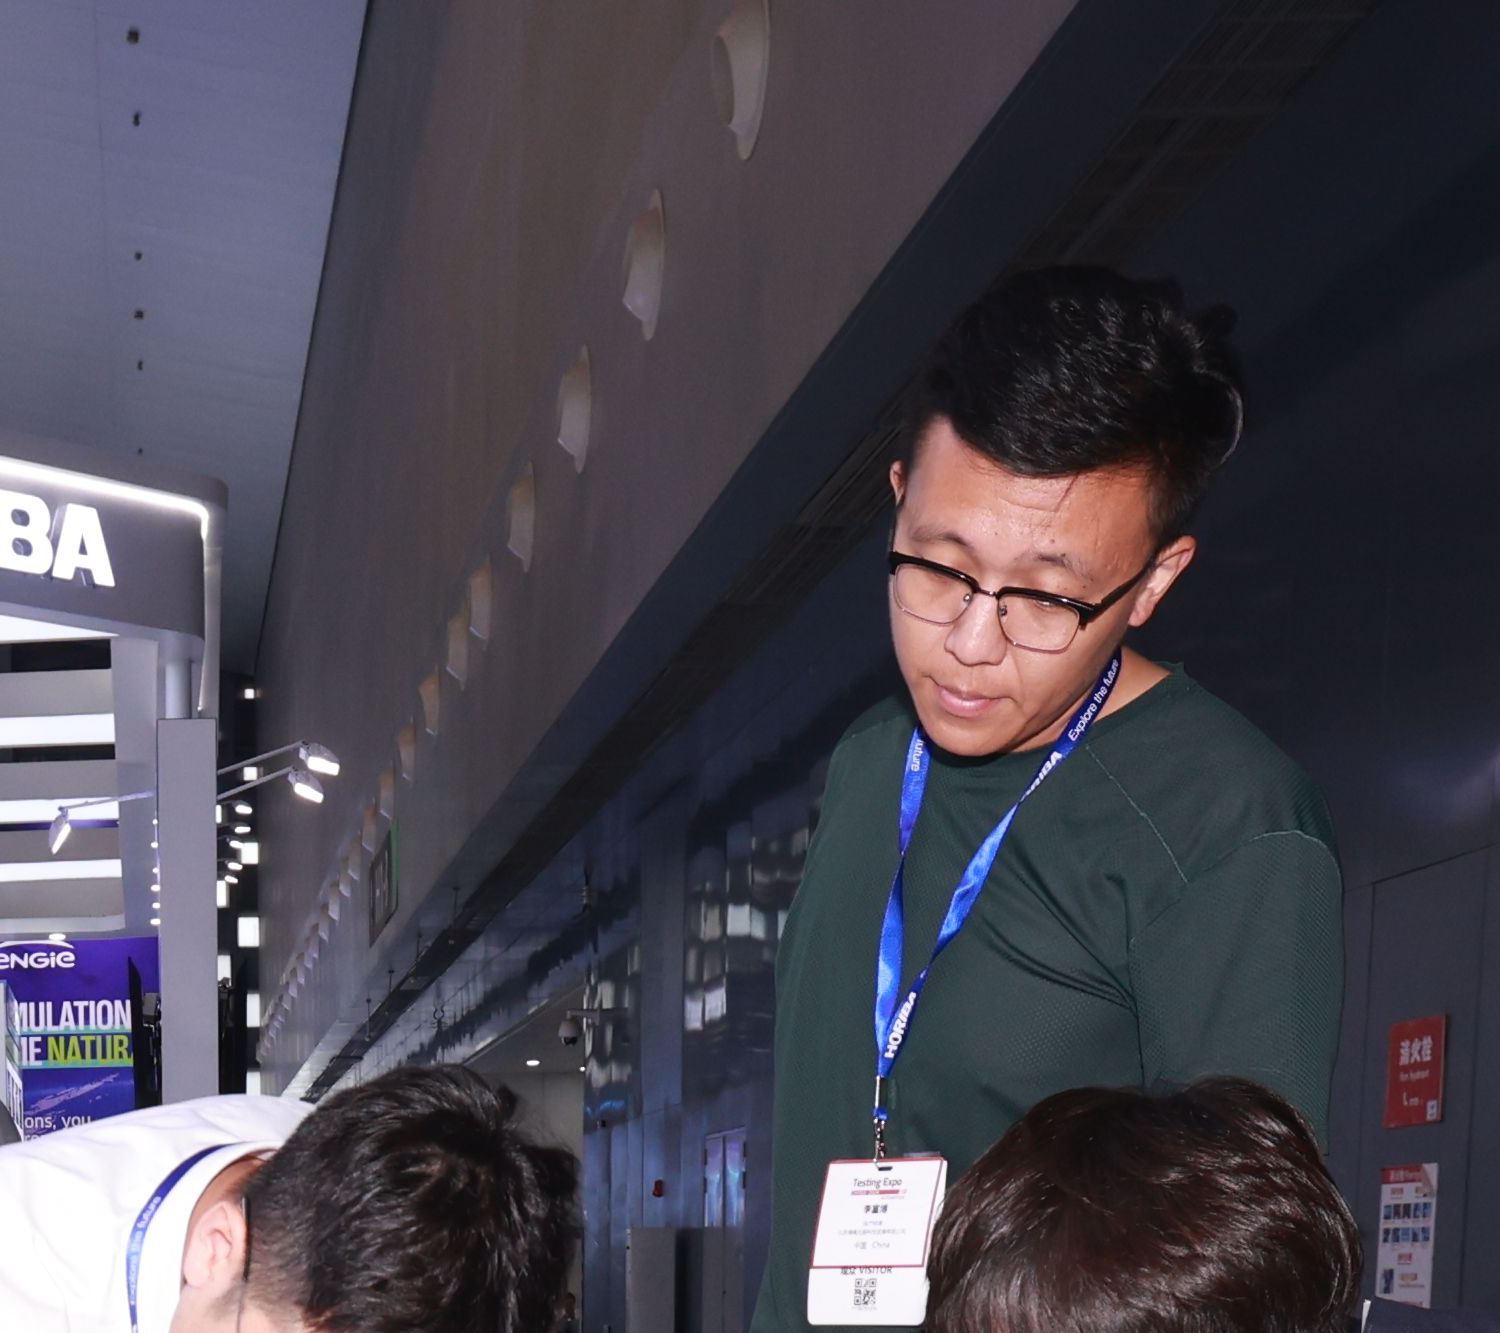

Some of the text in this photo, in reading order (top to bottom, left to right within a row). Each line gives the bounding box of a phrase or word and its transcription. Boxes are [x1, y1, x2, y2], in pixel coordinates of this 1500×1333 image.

[1066, 657, 1120, 742] Explore the future
[884, 990, 918, 1059] HORIBA
[47, 1034, 132, 1065] NATUR
[853, 1177, 902, 1190] Testing Expo
[858, 1266, 893, 1275] VISITOR
